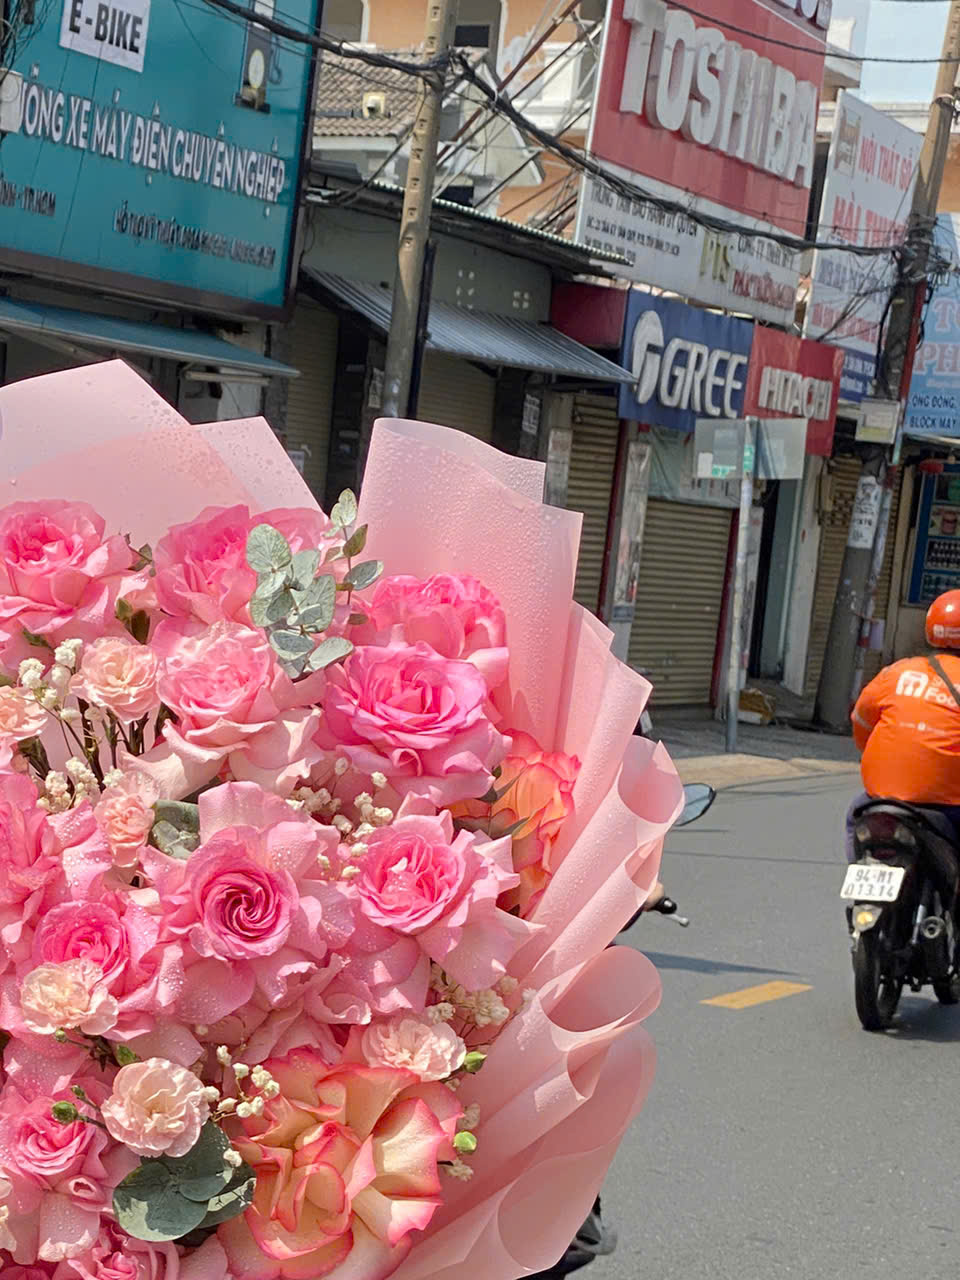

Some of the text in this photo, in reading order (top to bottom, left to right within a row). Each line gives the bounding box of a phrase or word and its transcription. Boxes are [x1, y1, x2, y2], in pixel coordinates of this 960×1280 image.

[95, 2, 143, 54] BIKE
[620, 0, 818, 189] TOSHIBA
[66, 95, 92, 149] XE
[92, 88, 132, 160] MÁY
[132, 100, 172, 185] ĐIỆN
[173, 120, 235, 189] CHUYÊN
[234, 136, 286, 217] NGHIỆP
[659, 337, 749, 419] GREE
[758, 366, 833, 421] HITACHI
